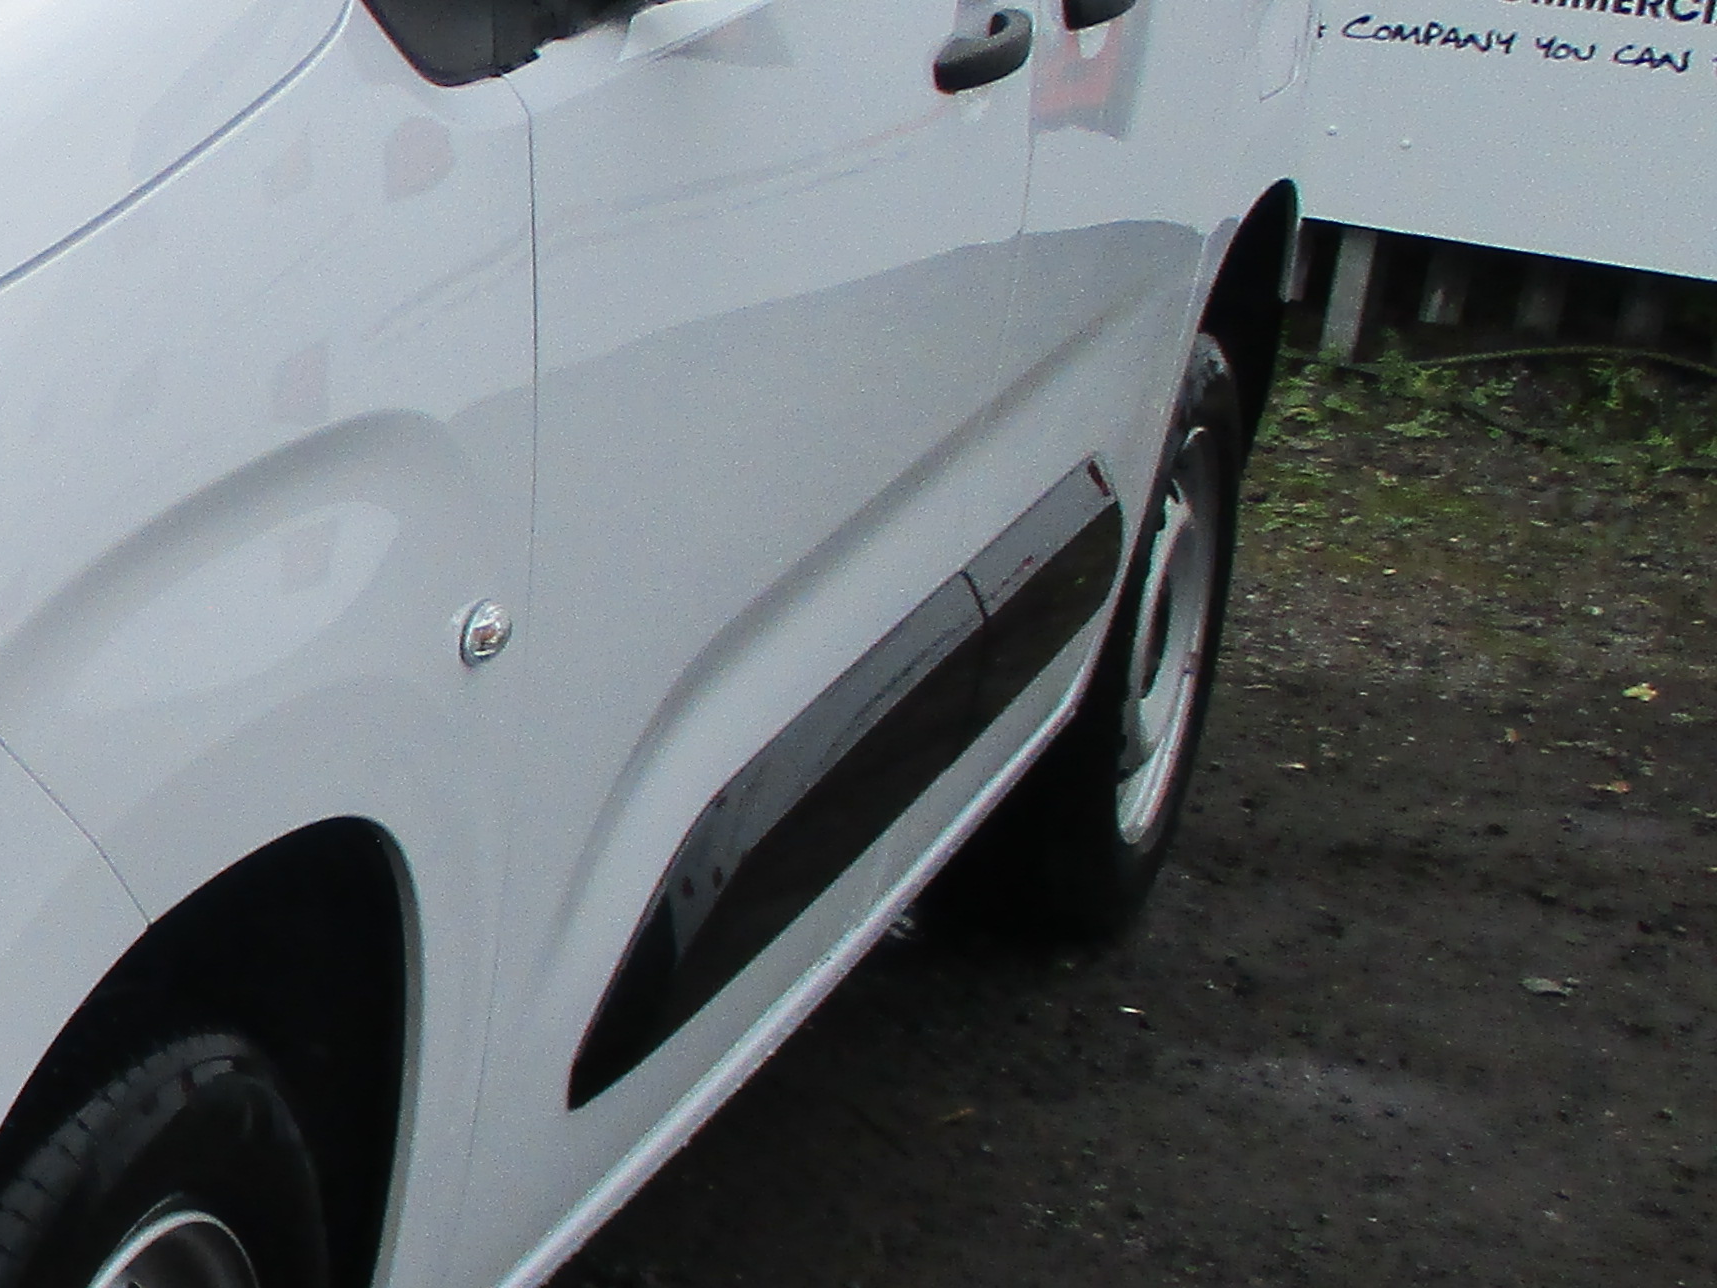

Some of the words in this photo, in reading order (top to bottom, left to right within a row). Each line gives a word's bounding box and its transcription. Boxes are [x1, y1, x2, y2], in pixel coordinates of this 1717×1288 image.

[1341, 14, 1519, 56] COMPANY
[1535, 34, 1597, 62] YOU
[1612, 43, 1692, 74] CAN
